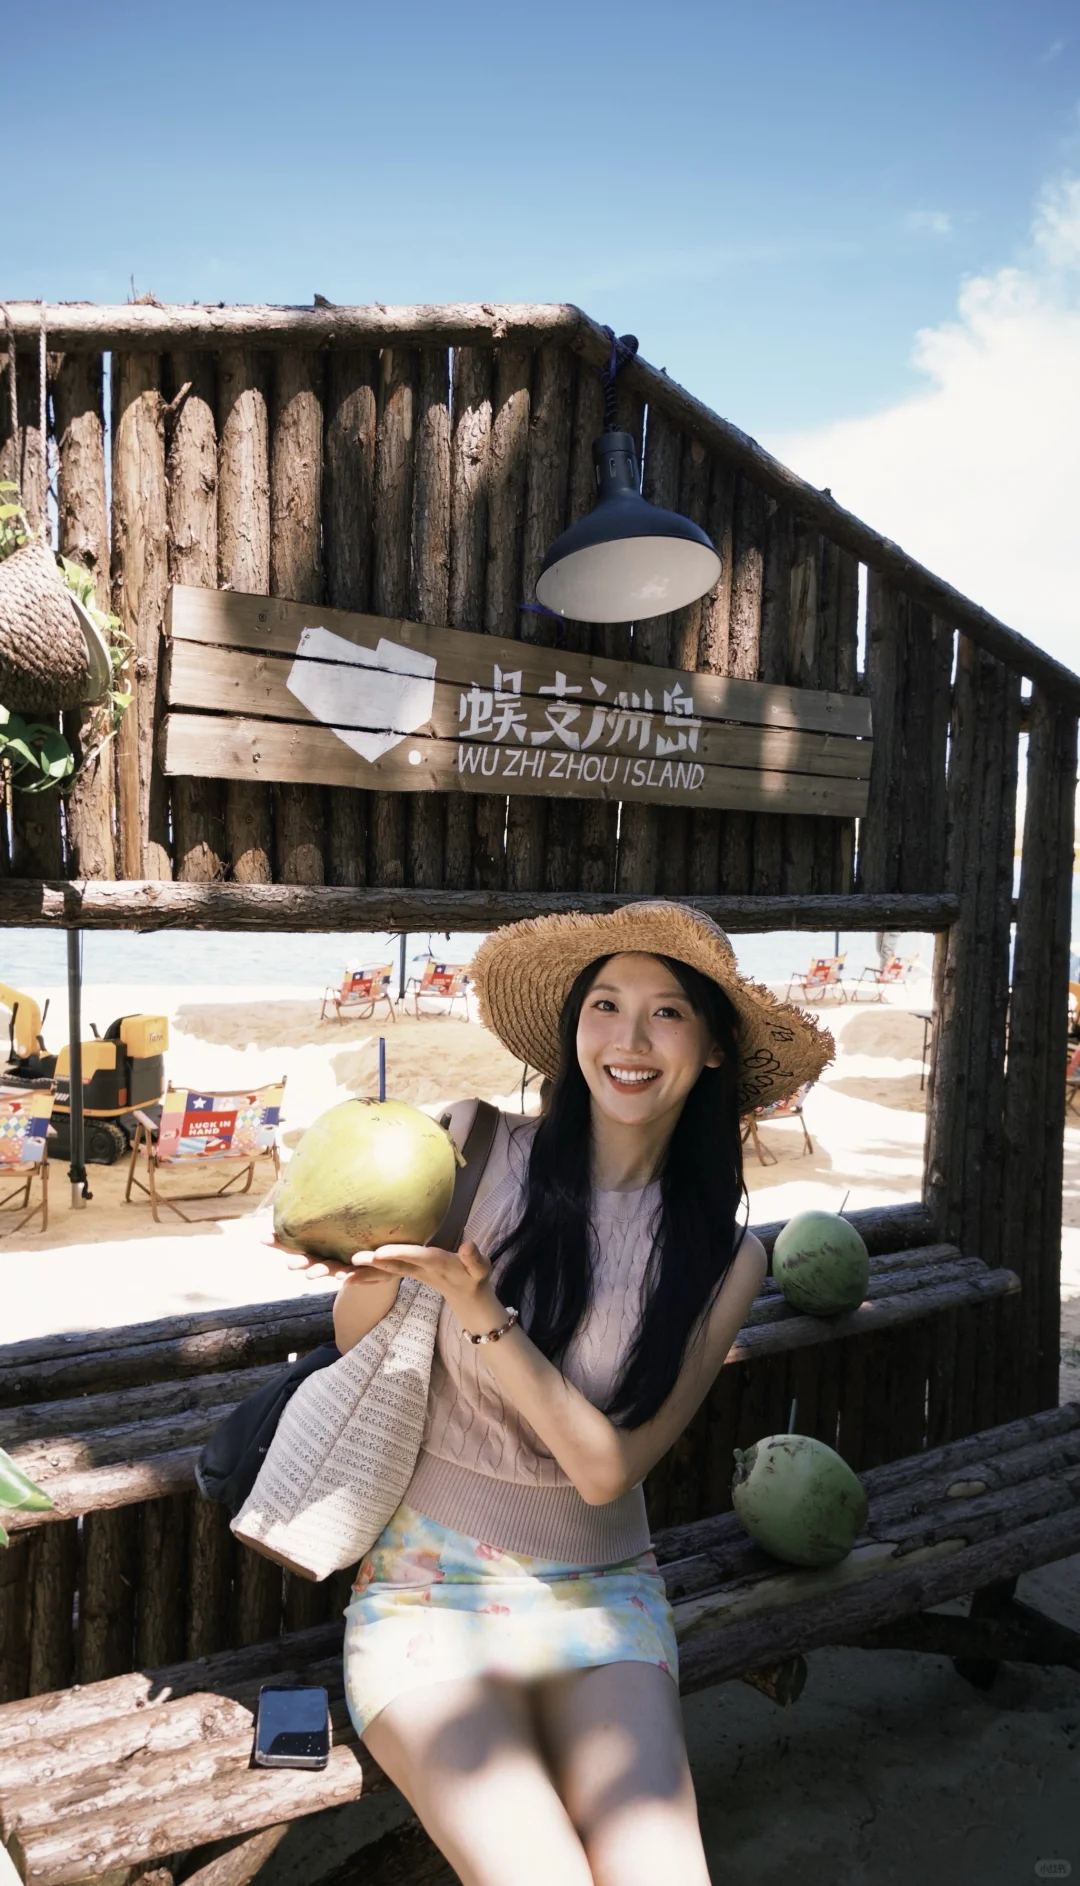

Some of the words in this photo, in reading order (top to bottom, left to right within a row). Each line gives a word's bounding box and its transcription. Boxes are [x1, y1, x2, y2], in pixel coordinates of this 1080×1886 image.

[458, 664, 702, 756] 蜈支洲岛
[458, 744, 500, 776] WU
[623, 759, 705, 790] ISLAND
[219, 1120, 231, 1128] IN
